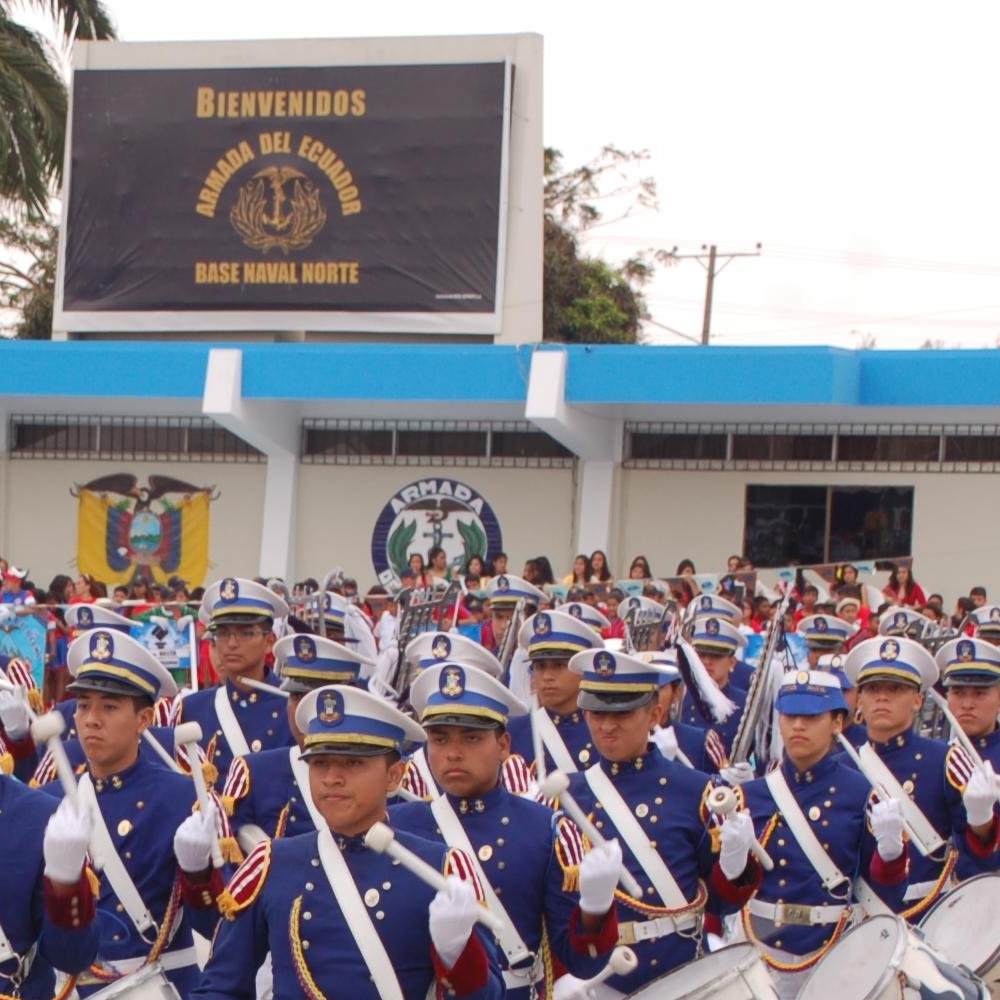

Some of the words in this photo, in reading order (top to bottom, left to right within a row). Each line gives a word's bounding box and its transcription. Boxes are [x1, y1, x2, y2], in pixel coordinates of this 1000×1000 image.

[196, 87, 366, 118] BIENVENIDOS
[196, 140, 255, 218] ARMADA
[259, 131, 292, 155] DEL
[297, 135, 362, 216] ECUADOR
[195, 262, 240, 284] BASE
[243, 262, 298, 284] NAVAL
[302, 262, 359, 284] NORTE
[390, 480, 484, 515] ARMADA
